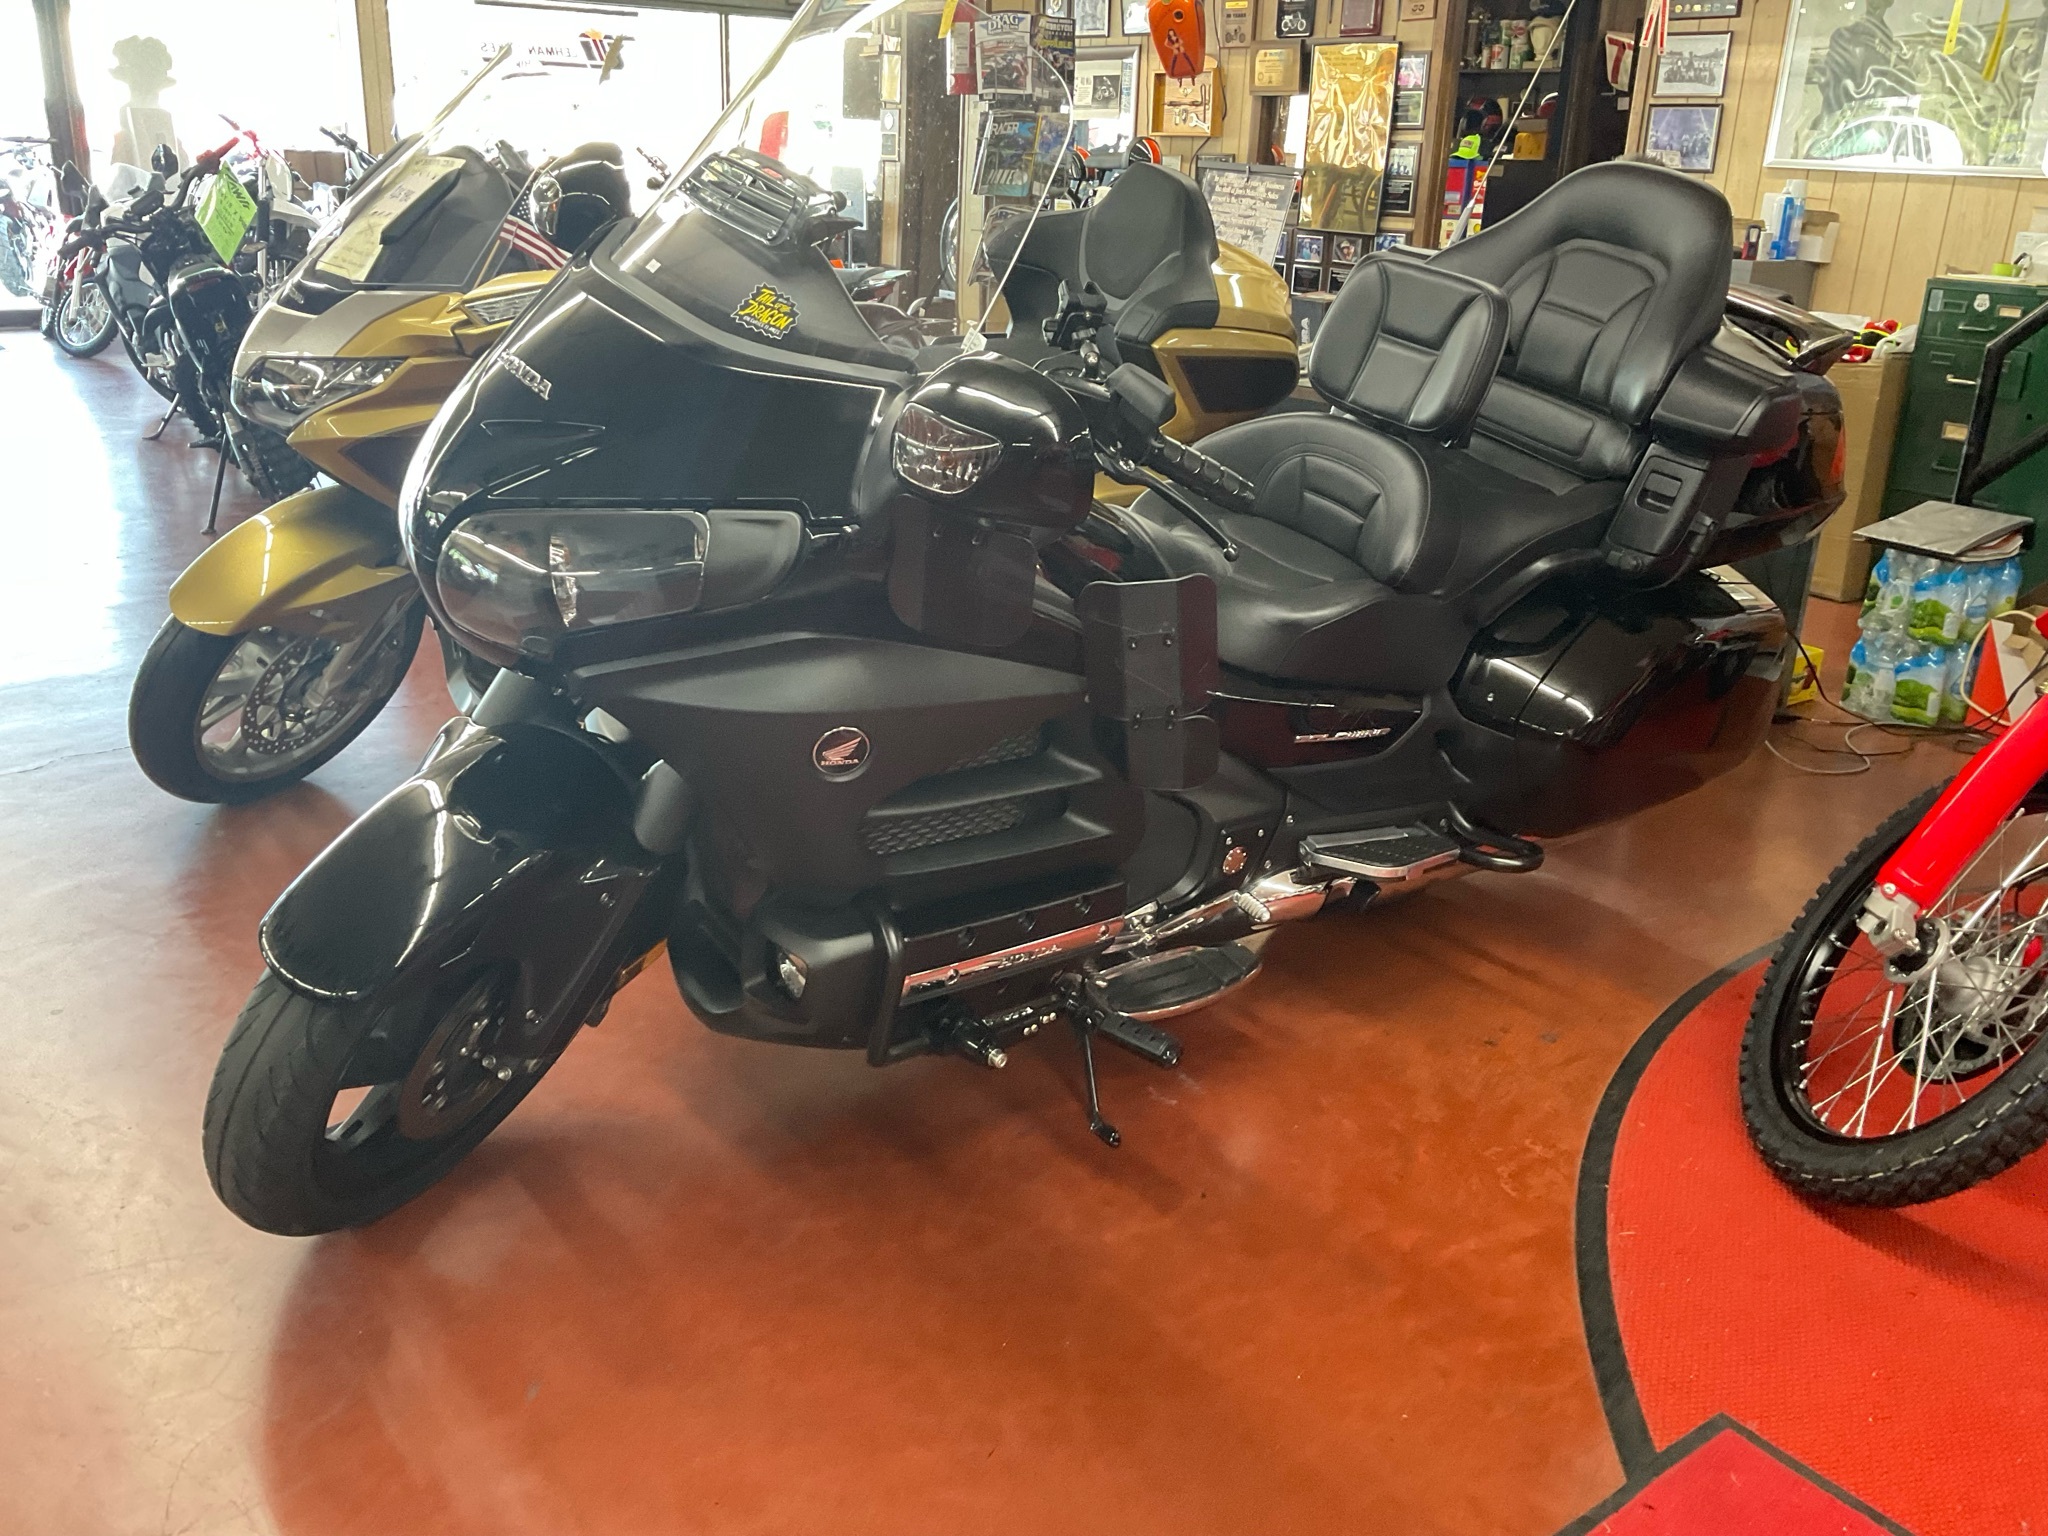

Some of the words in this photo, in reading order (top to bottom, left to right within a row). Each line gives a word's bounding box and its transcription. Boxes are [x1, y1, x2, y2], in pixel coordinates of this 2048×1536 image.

[756, 288, 777, 307] TAIL
[738, 299, 793, 330] DRAGON
[820, 758, 860, 766] HONDA
